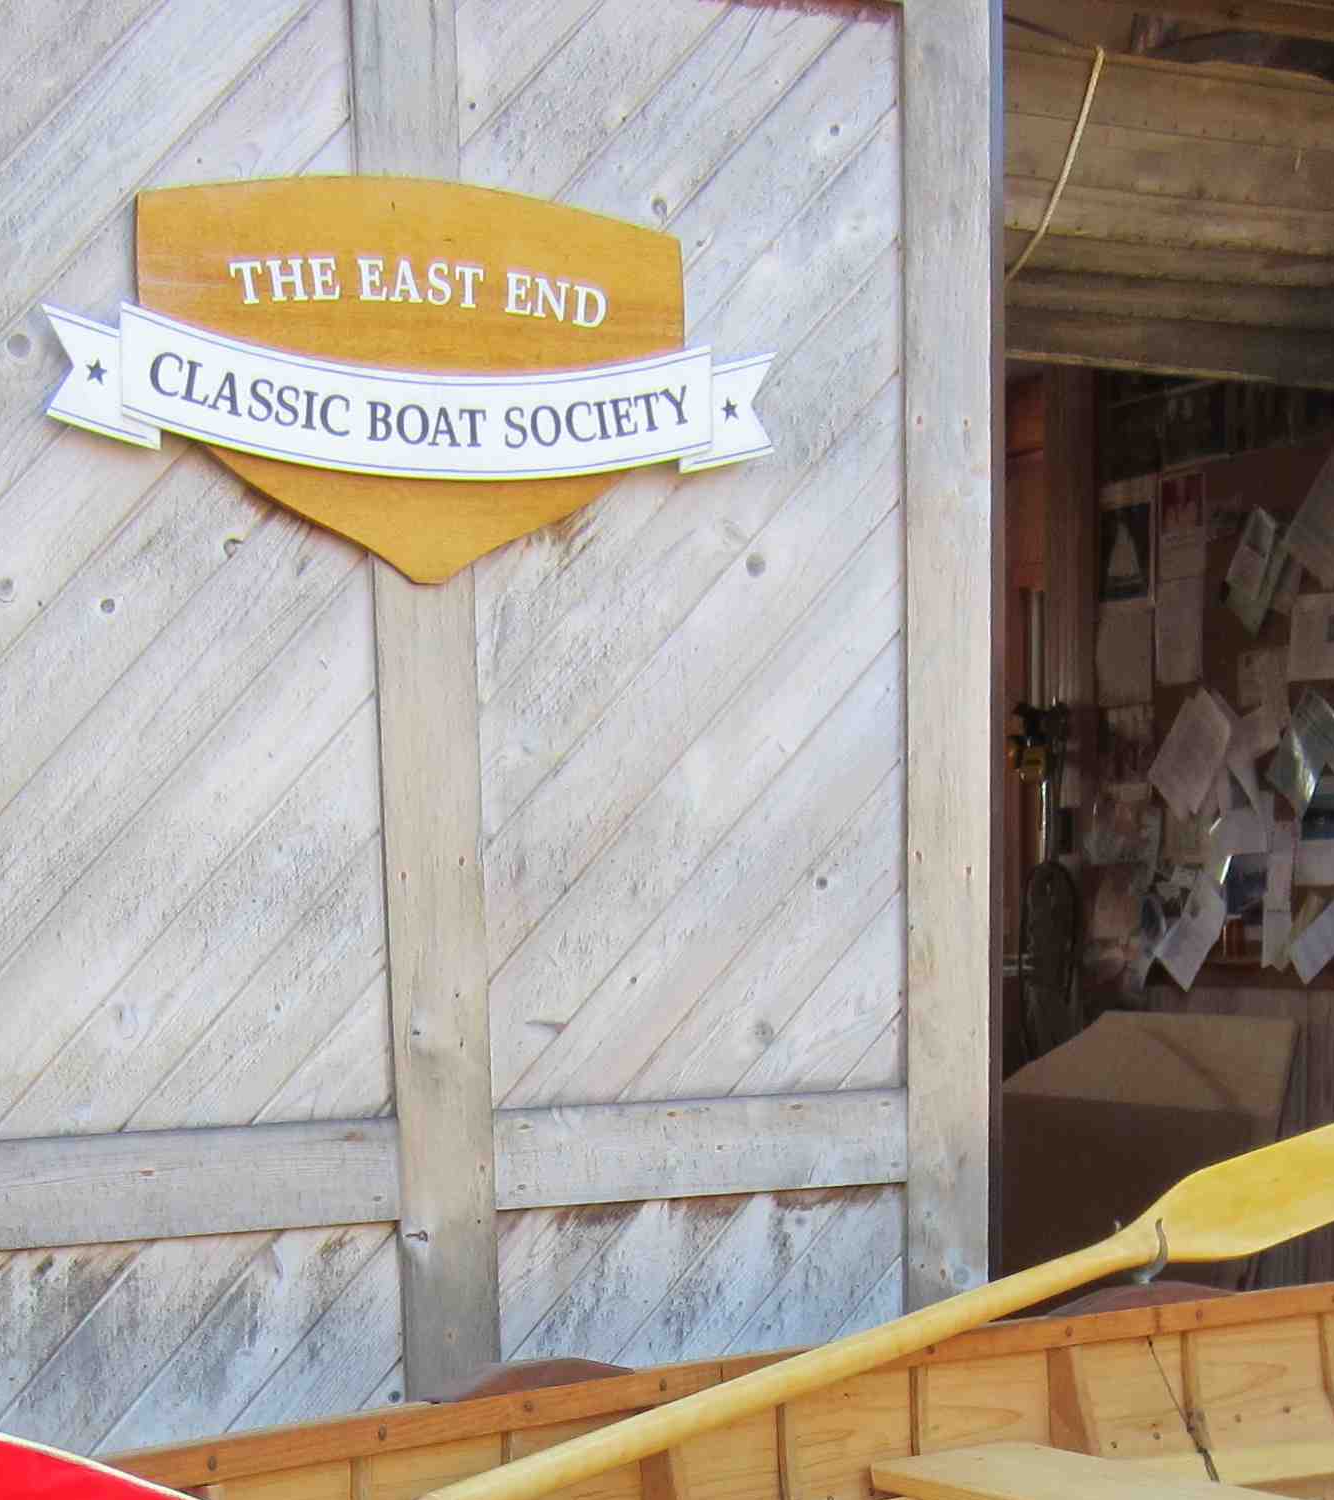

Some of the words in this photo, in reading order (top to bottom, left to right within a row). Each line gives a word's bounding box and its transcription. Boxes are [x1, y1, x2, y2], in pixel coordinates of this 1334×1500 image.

[229, 257, 341, 304] THE
[357, 257, 484, 309] EAST
[504, 271, 608, 328] END
[149, 352, 351, 437] CLASSIC
[367, 400, 487, 447] BOAT
[504, 385, 688, 449] SOCIETY
